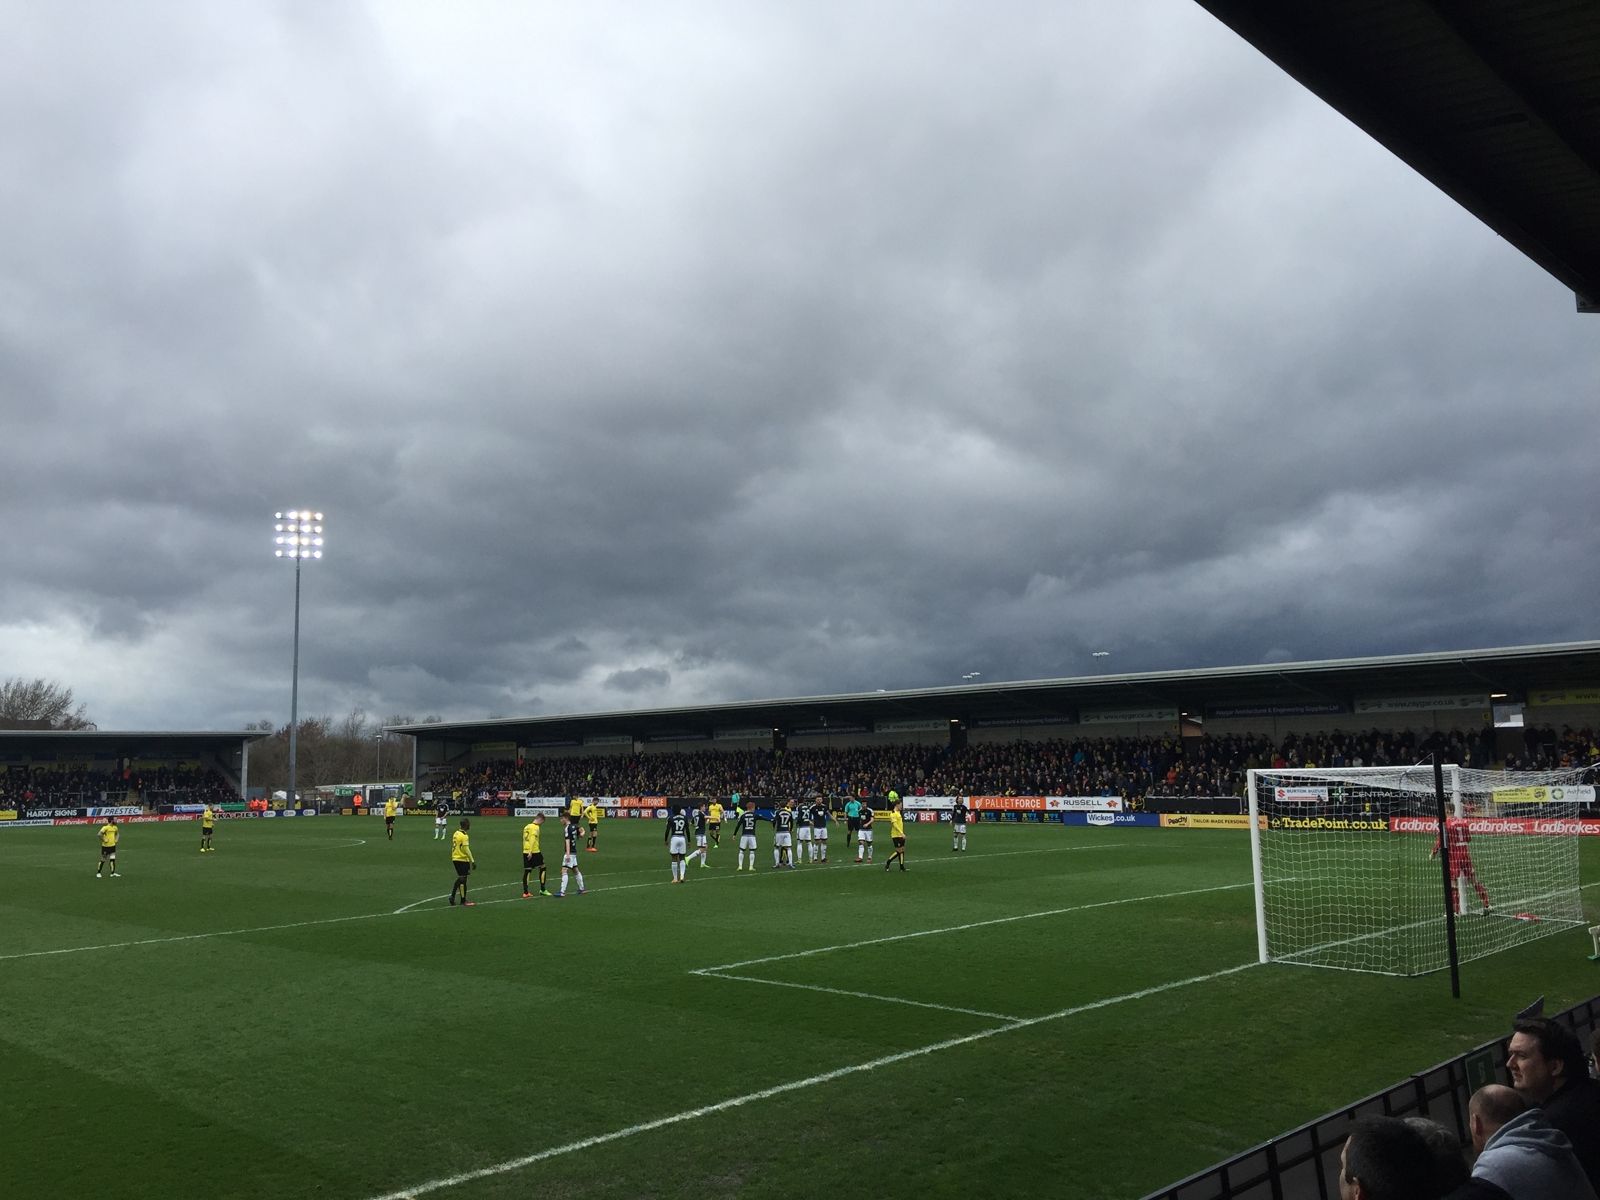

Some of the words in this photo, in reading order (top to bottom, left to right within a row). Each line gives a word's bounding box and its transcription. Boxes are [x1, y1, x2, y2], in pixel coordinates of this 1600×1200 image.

[985, 798, 1041, 808] PALLETFORCE
[1063, 798, 1103, 806] RUSSELL
[26, 810, 53, 818] HARDY
[54, 809, 78, 817] SIGNS
[103, 807, 140, 815] PRESTEC
[606, 808, 617, 818] sky
[617, 809, 628, 817] BET
[630, 808, 640, 818] sky
[641, 809, 652, 817] BET
[744, 817, 755, 827] 15
[779, 815, 790, 825] 17
[903, 812, 917, 822] sky
[920, 812, 935, 821] BET
[1168, 816, 1188, 825] Peachy
[673, 819, 685, 830] 19
[1281, 817, 1388, 830] TradePoint.co.uk
[1394, 818, 1440, 832] Ladbrok
[1468, 820, 1525, 832] adbrokes
[1534, 820, 1600, 833] Ladbrokes
[1456, 826, 1464, 842] 1
